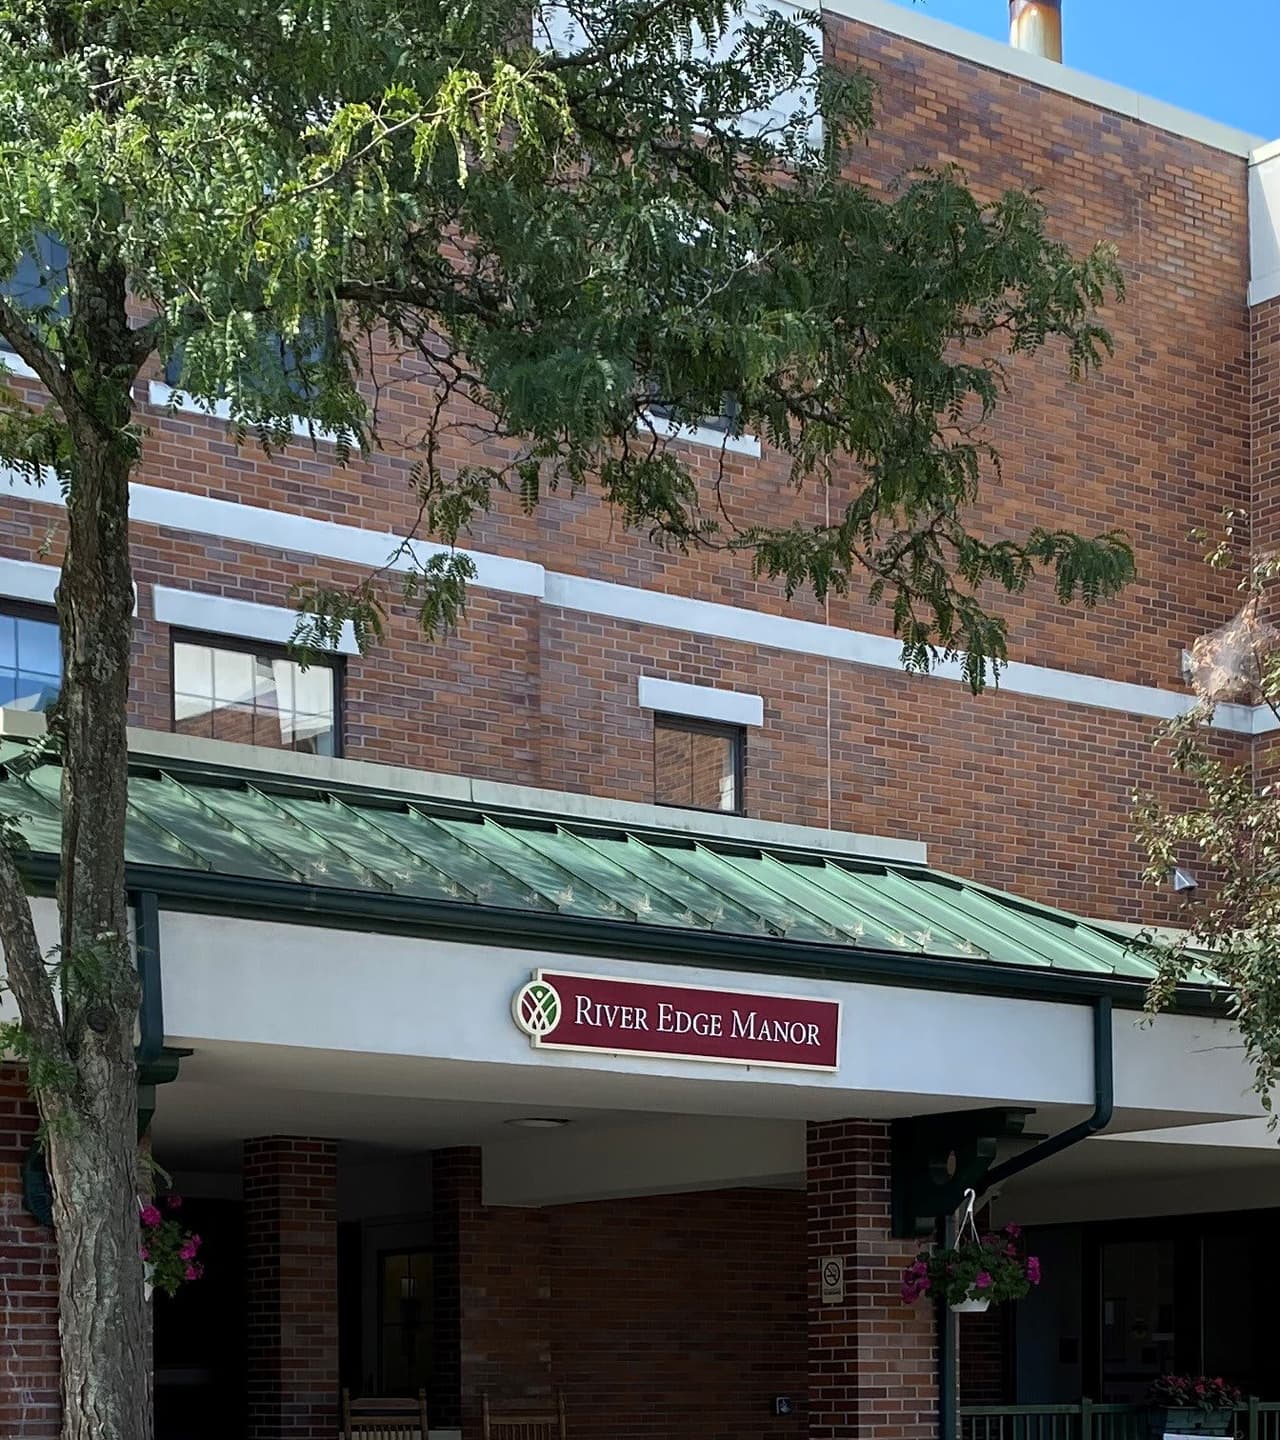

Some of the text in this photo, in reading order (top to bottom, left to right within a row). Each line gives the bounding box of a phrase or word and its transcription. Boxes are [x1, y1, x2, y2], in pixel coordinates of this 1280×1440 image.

[574, 995, 821, 1047] RIVER EDGE MANOR
